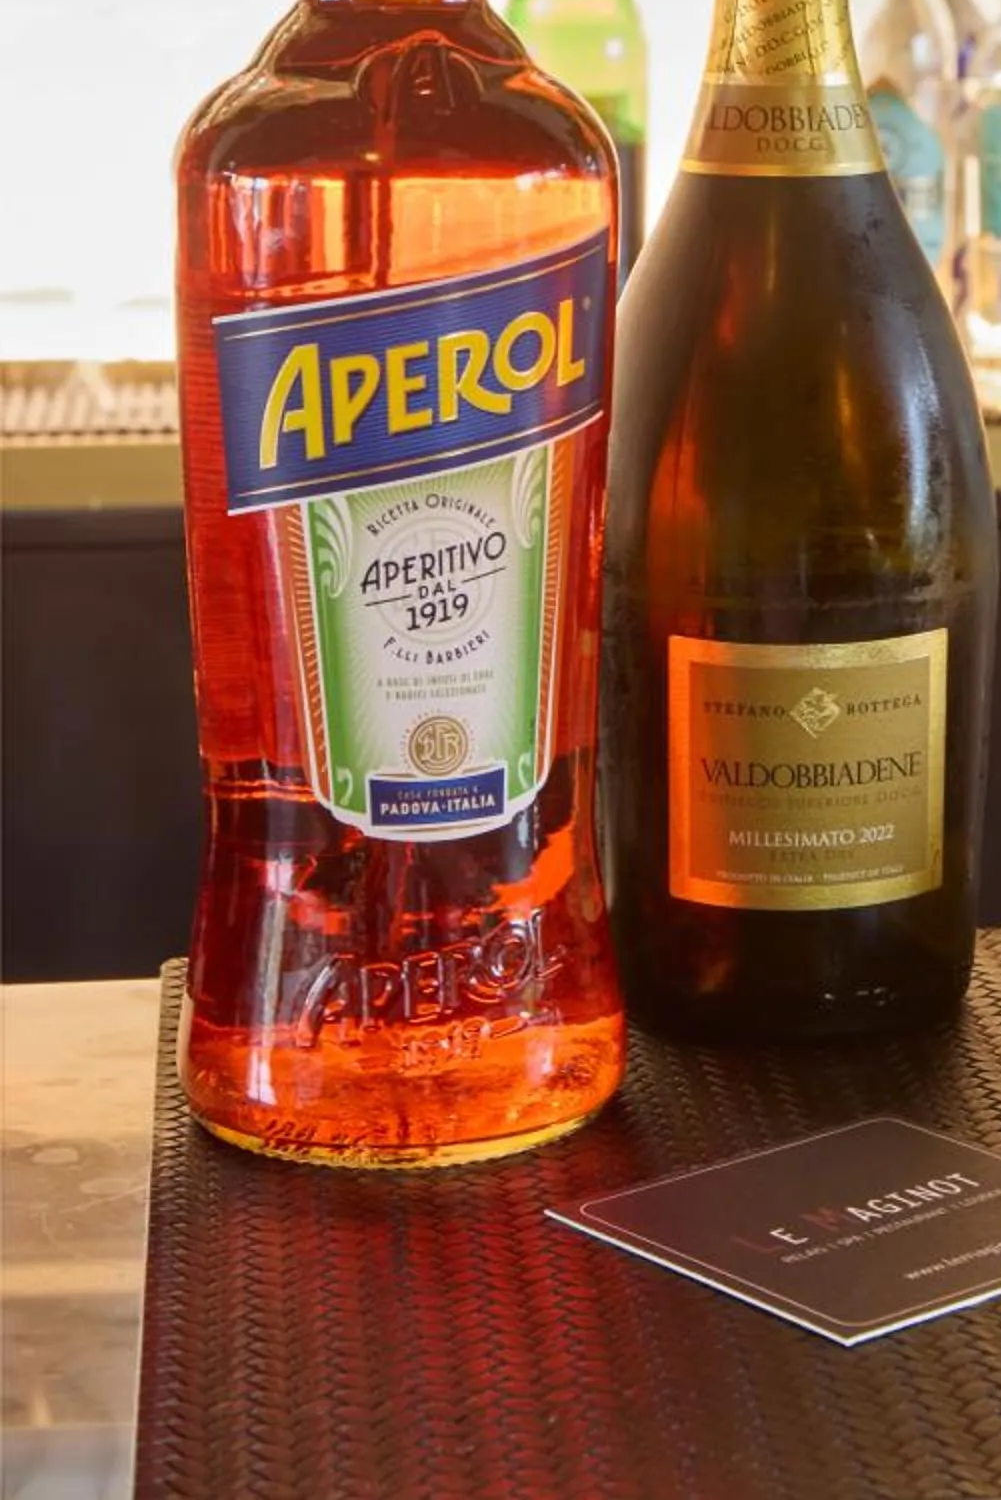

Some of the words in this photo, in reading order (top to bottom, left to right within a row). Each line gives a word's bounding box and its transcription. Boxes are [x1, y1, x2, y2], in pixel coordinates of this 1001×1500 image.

[259, 298, 586, 469] APEROL
[366, 499, 419, 536] RICETTA
[425, 492, 497, 529] ORIGINALE
[360, 531, 507, 594] APERITIVO
[418, 579, 457, 599] DAL
[406, 593, 469, 631] 1919
[426, 629, 490, 665] BARBIERI
[846, 693, 922, 717] BOTTEGA
[700, 750, 922, 789] VALDOBBIADENE
[380, 801, 440, 816] PADOVA
[447, 794, 497, 813] ITALIA
[729, 830, 855, 847] MILLESIMATO
[859, 824, 896, 844] 2022
[299, 907, 568, 1048] APEROL
